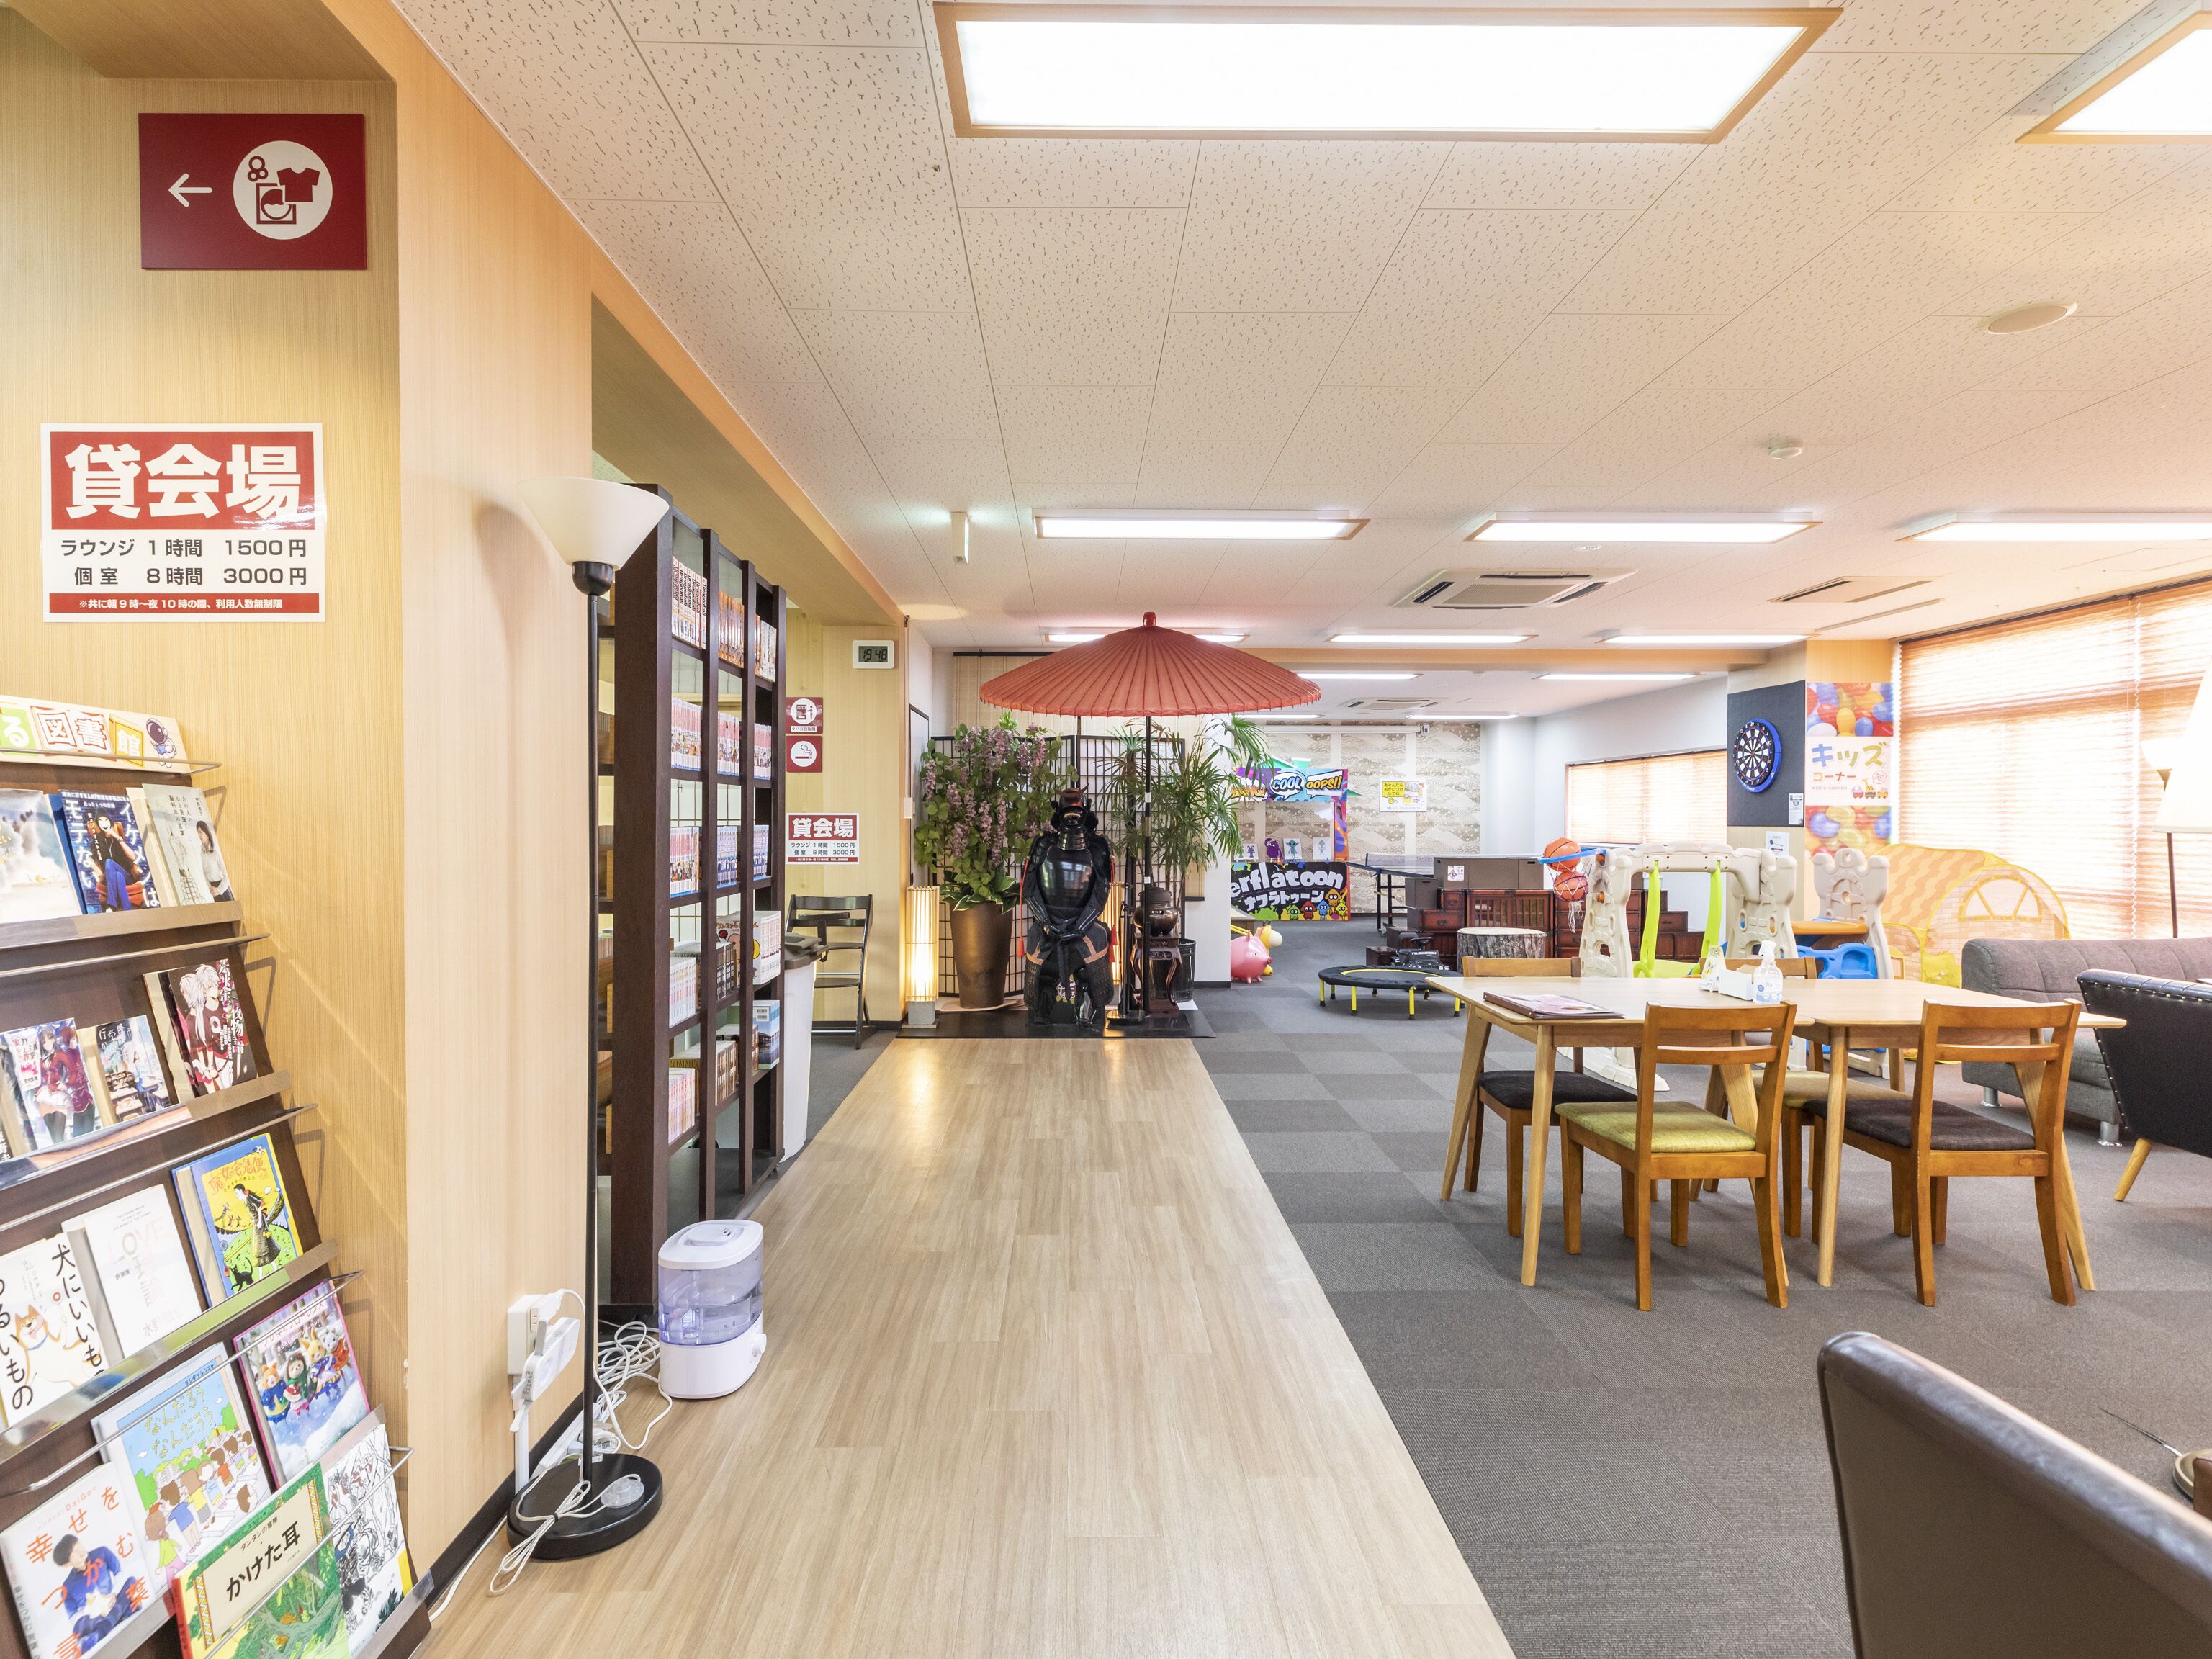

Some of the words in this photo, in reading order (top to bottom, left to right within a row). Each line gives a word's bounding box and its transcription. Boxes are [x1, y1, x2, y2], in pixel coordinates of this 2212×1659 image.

[65, 443, 301, 519] 貸会場
[60, 539, 135, 557] ラウンジ
[1812, 741, 1888, 768] キッズ
[1272, 776, 1303, 792] COOL
[1305, 775, 1343, 791] OOPS!!
[1812, 772, 1856, 782] コーナー
[65, 799, 102, 889] モテない
[793, 818, 853, 838] 貸会場
[107, 1217, 171, 1264] LOVE
[52, 1244, 105, 1376] 犬にいいも
[145, 1384, 206, 1436] なんだろう
[152, 1406, 215, 1459] なんだろう
[240, 1516, 278, 1552] タンタンの冒険
[226, 1521, 300, 1602] かけた耳
